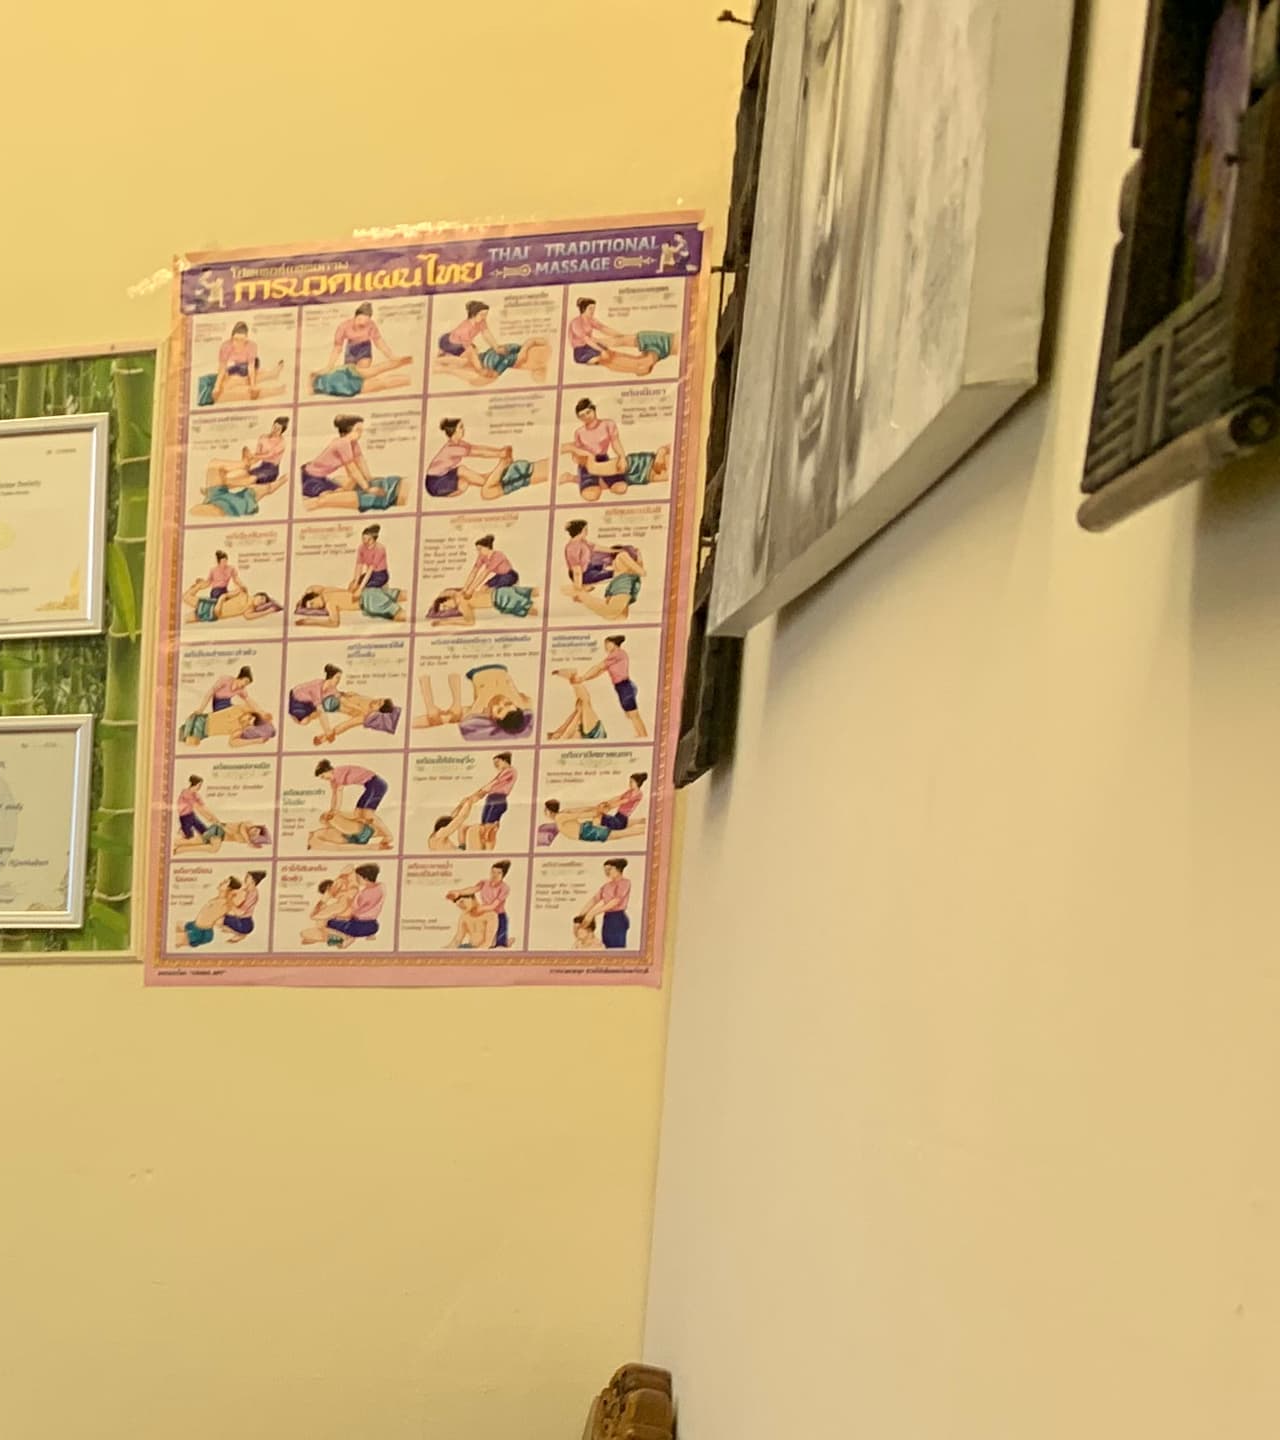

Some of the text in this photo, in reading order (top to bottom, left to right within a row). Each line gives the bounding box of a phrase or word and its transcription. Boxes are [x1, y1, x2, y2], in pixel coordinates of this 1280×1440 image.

[489, 235, 659, 262] THAI TRADITIONAL
[535, 256, 610, 276] MASSAGE
